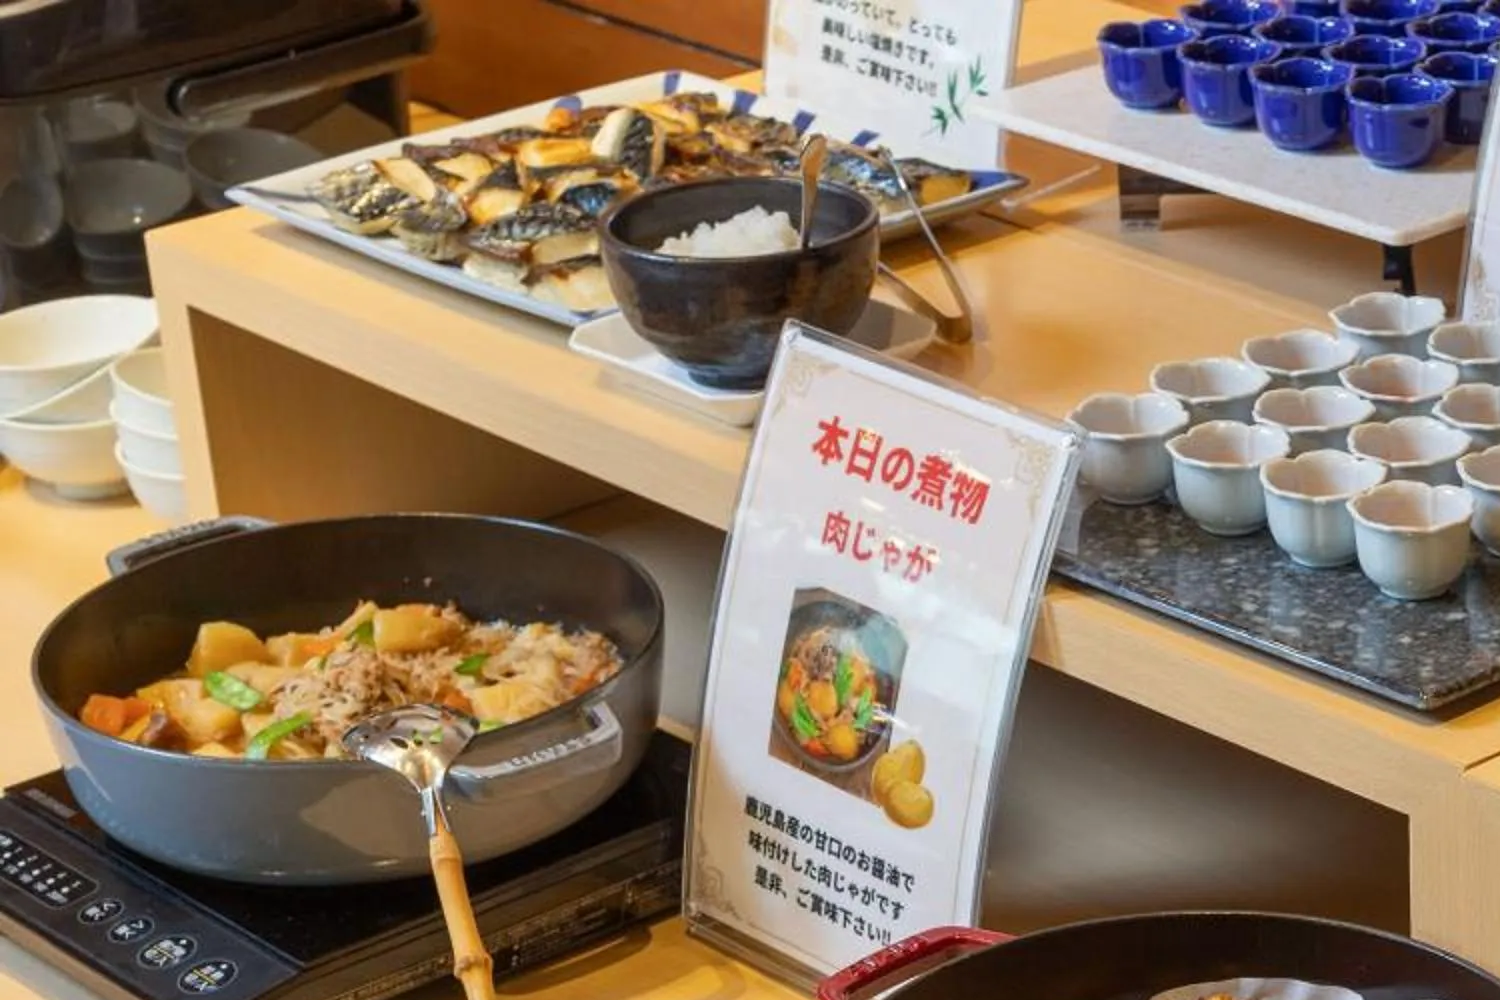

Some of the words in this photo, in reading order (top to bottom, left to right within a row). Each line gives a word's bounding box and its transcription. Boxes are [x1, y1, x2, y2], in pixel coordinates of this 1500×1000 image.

[812, 415, 991, 525] 本日の煮物
[822, 511, 937, 583] 肉じゃが
[748, 830, 905, 920] 味付けした肉じゃがです
